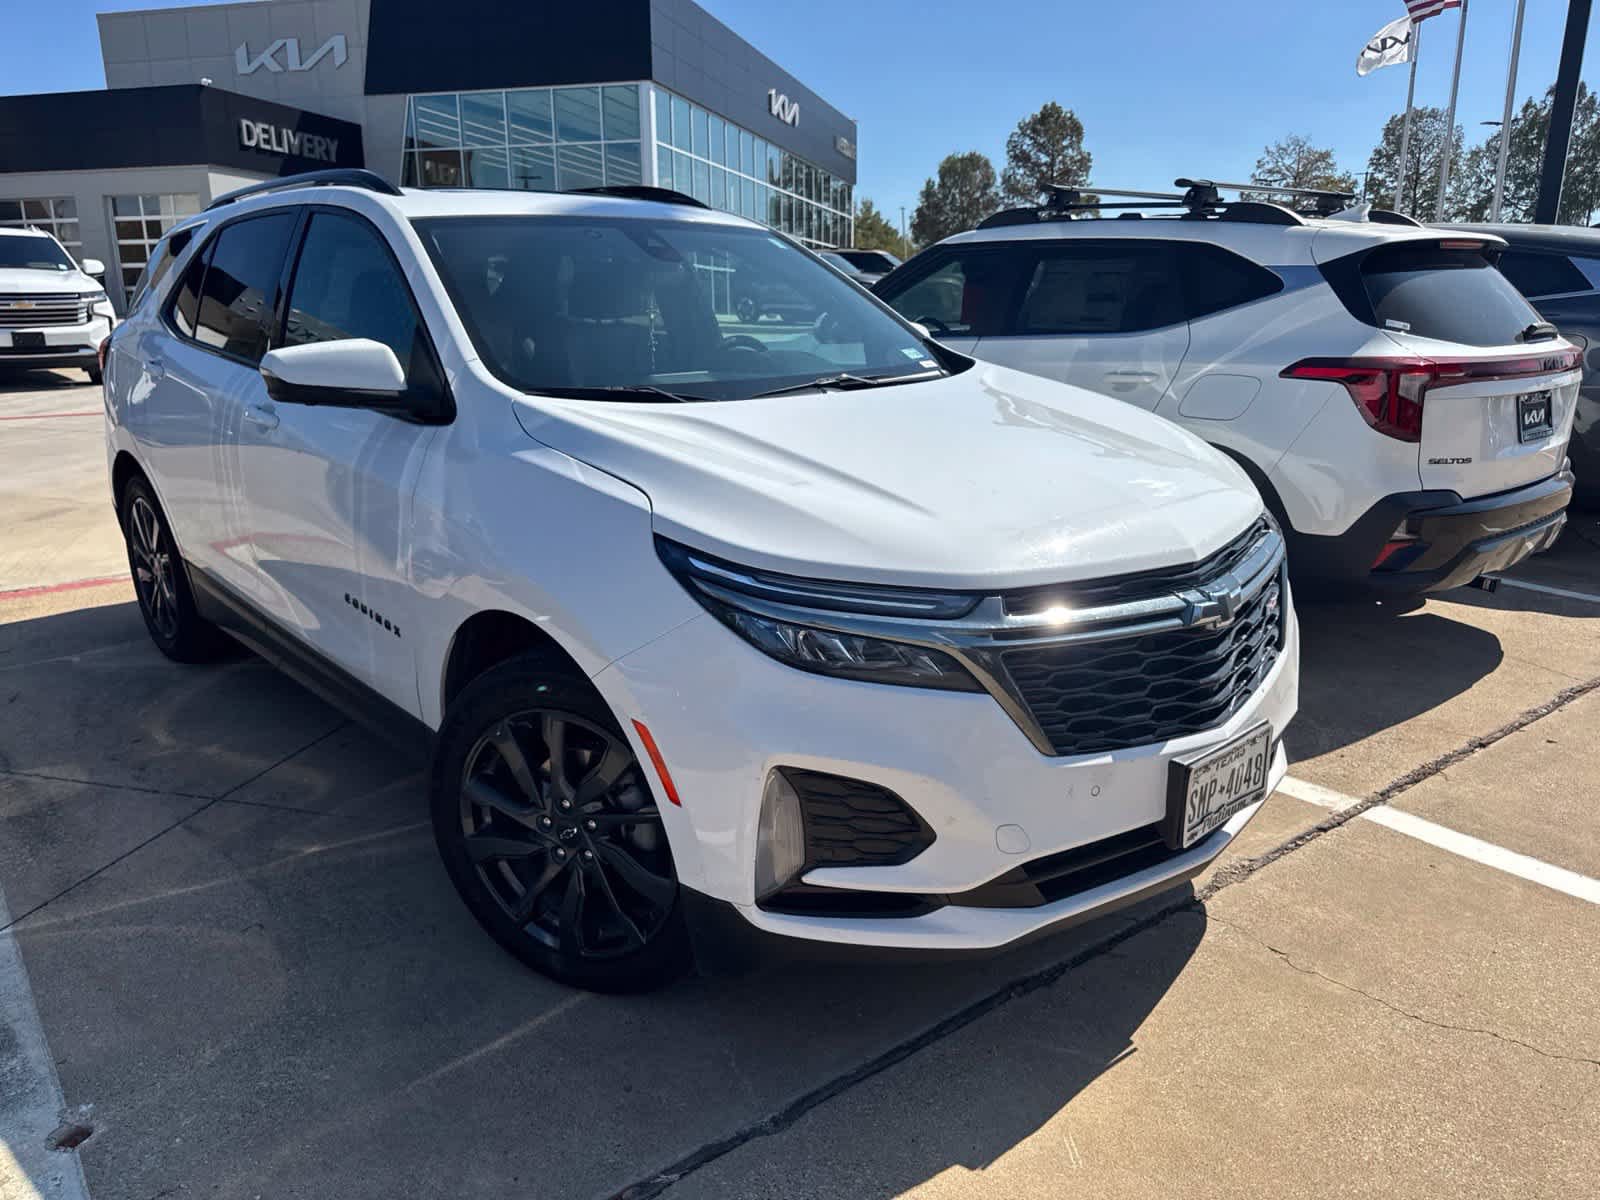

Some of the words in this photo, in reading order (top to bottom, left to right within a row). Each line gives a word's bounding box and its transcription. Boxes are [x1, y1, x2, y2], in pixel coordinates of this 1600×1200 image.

[235, 33, 348, 74] KIA
[768, 88, 799, 128] KIA
[241, 118, 339, 162] DELIVERY
[1524, 408, 1545, 424] KIA
[345, 592, 401, 638] EQUINOX
